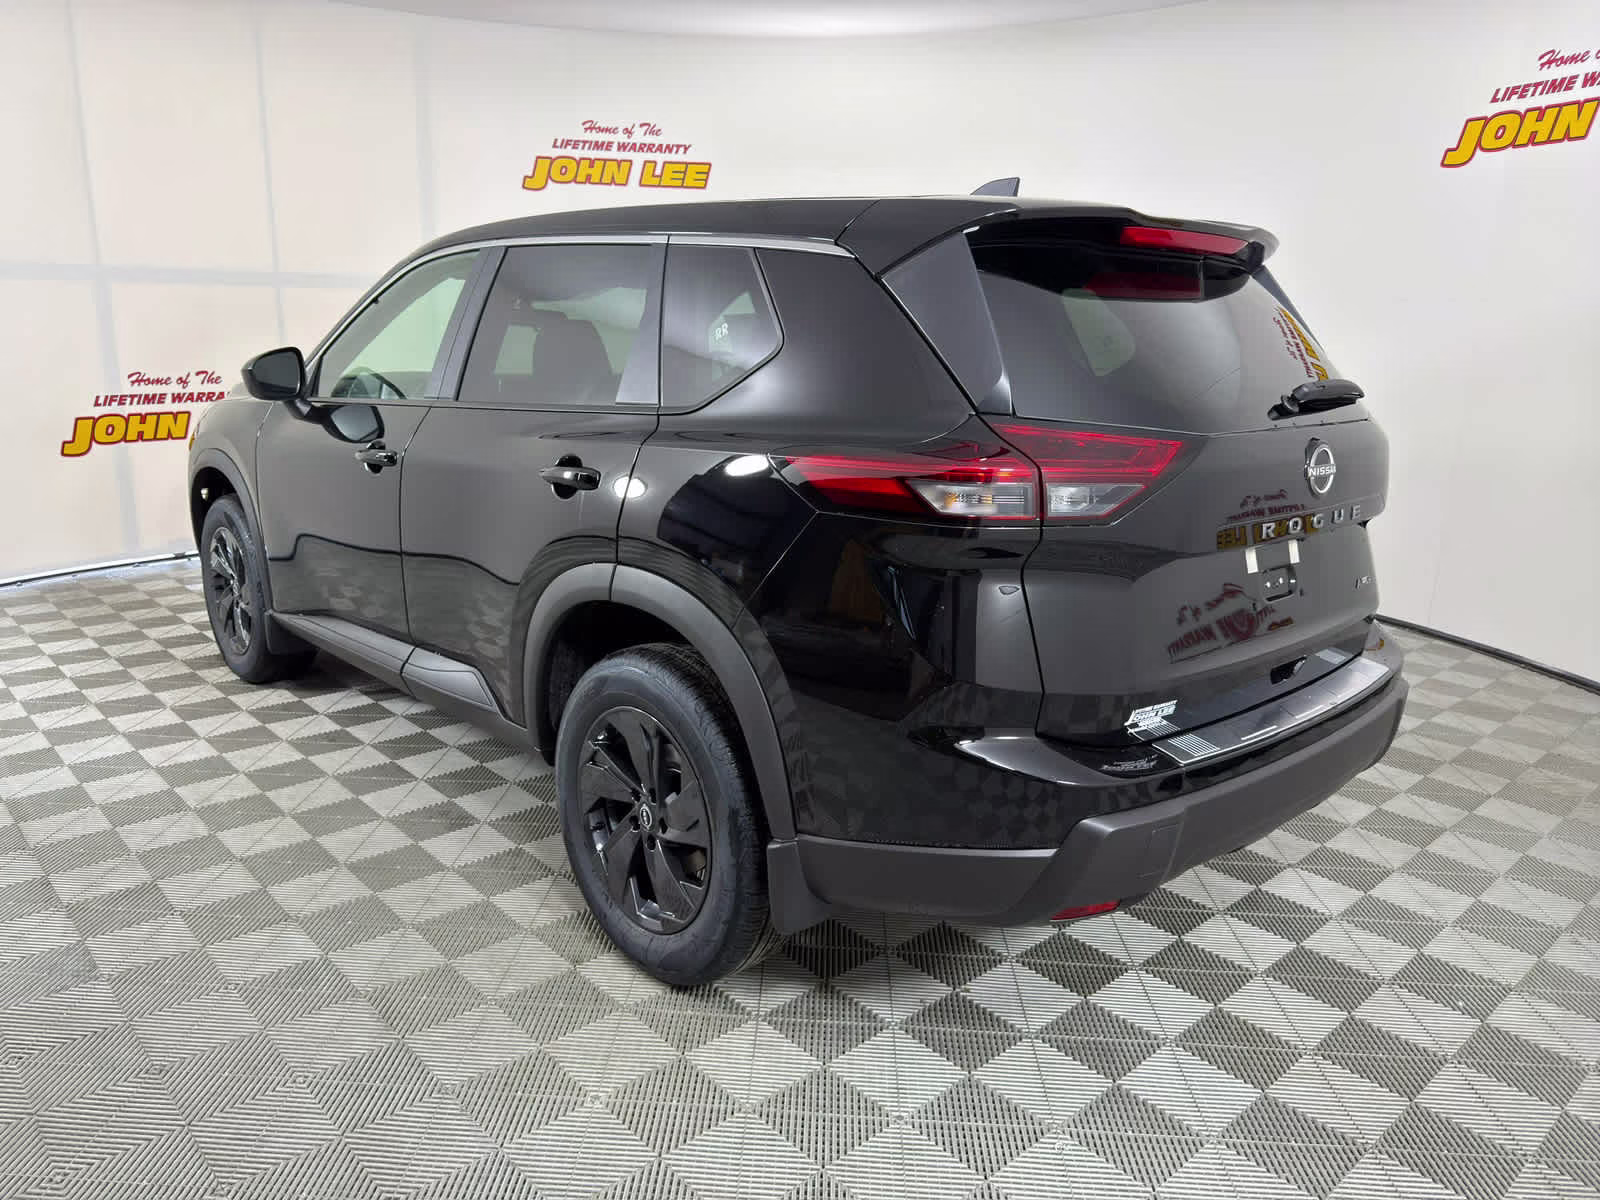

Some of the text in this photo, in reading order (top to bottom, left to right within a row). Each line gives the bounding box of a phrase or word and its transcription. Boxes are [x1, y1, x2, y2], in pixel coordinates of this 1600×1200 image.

[1537, 49, 1591, 71] Home
[1489, 74, 1580, 103] LIFETIME
[581, 119, 663, 139] Home of The
[1440, 96, 1600, 168] JOHN
[551, 138, 692, 155] LIFETIME WARRANTY
[522, 155, 712, 191] JOHN LEE
[127, 370, 224, 390] Home of The
[93, 391, 231, 408] LIFETIME WARRA
[61, 410, 191, 457] JOHN
[1308, 464, 1337, 477] NISSAN
[1261, 504, 1361, 540] ROGUE
